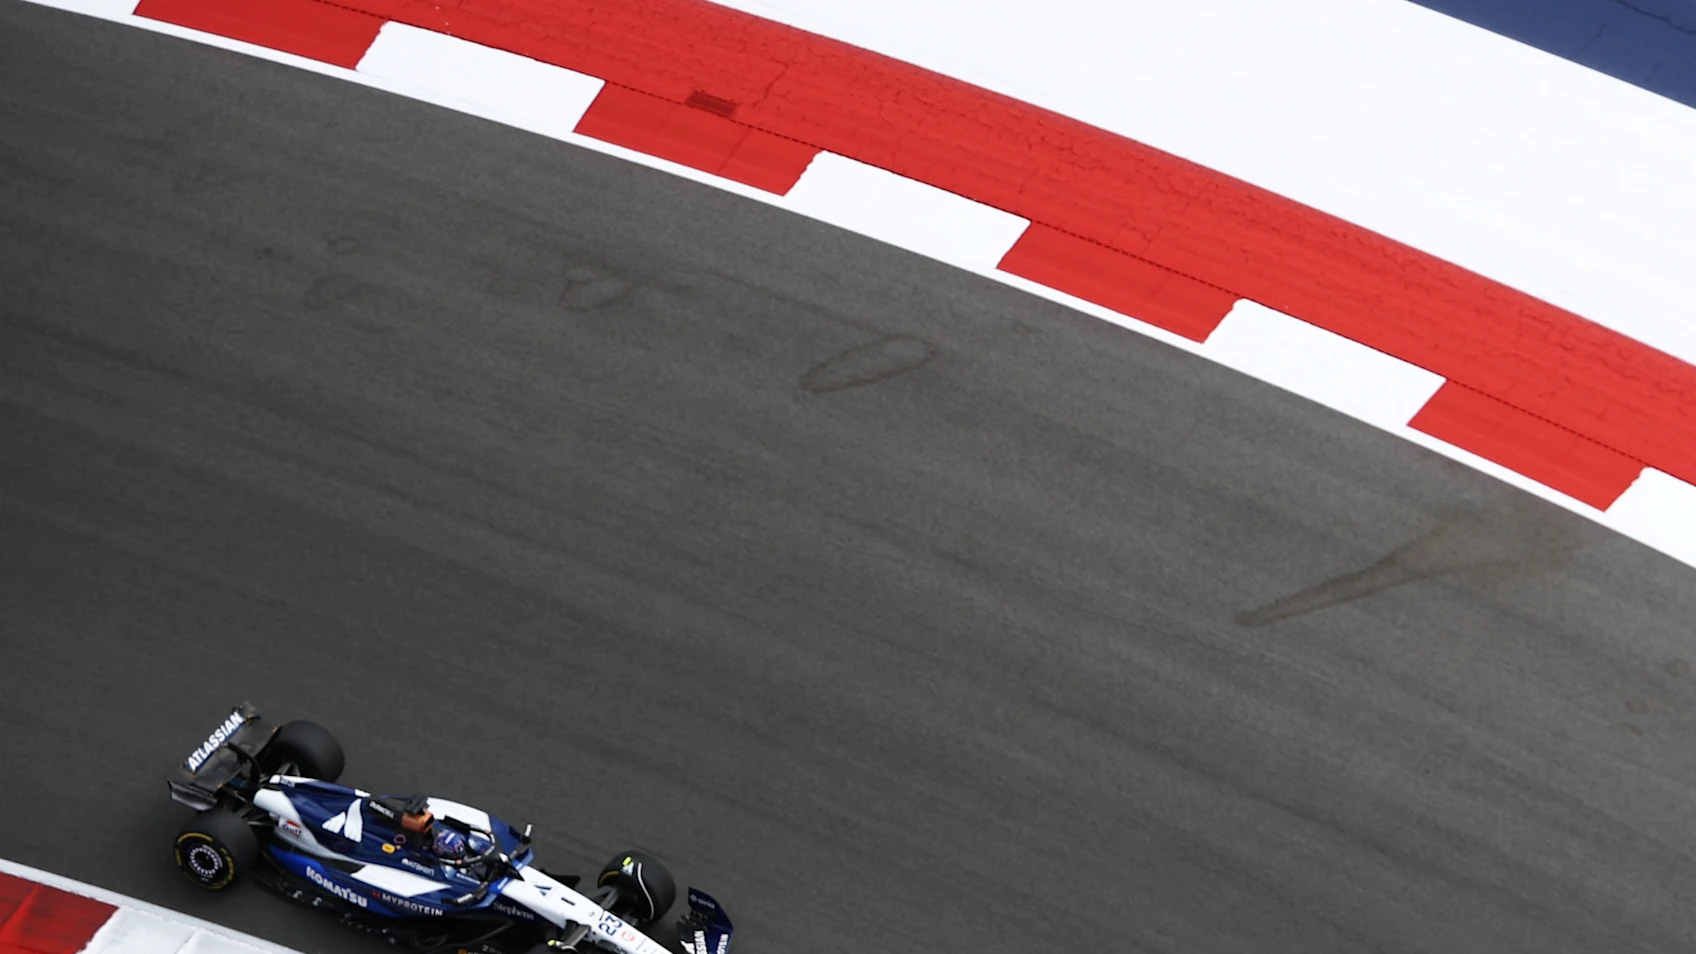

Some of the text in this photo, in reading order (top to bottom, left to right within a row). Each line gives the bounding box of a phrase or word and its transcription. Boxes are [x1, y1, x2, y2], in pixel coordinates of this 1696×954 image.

[187, 711, 245, 771] ATLASSIAN
[306, 865, 368, 908] KOMATSU
[381, 893, 444, 917] MYPROTEIN
[493, 900, 535, 921] Stephens
[599, 914, 624, 937] 23
